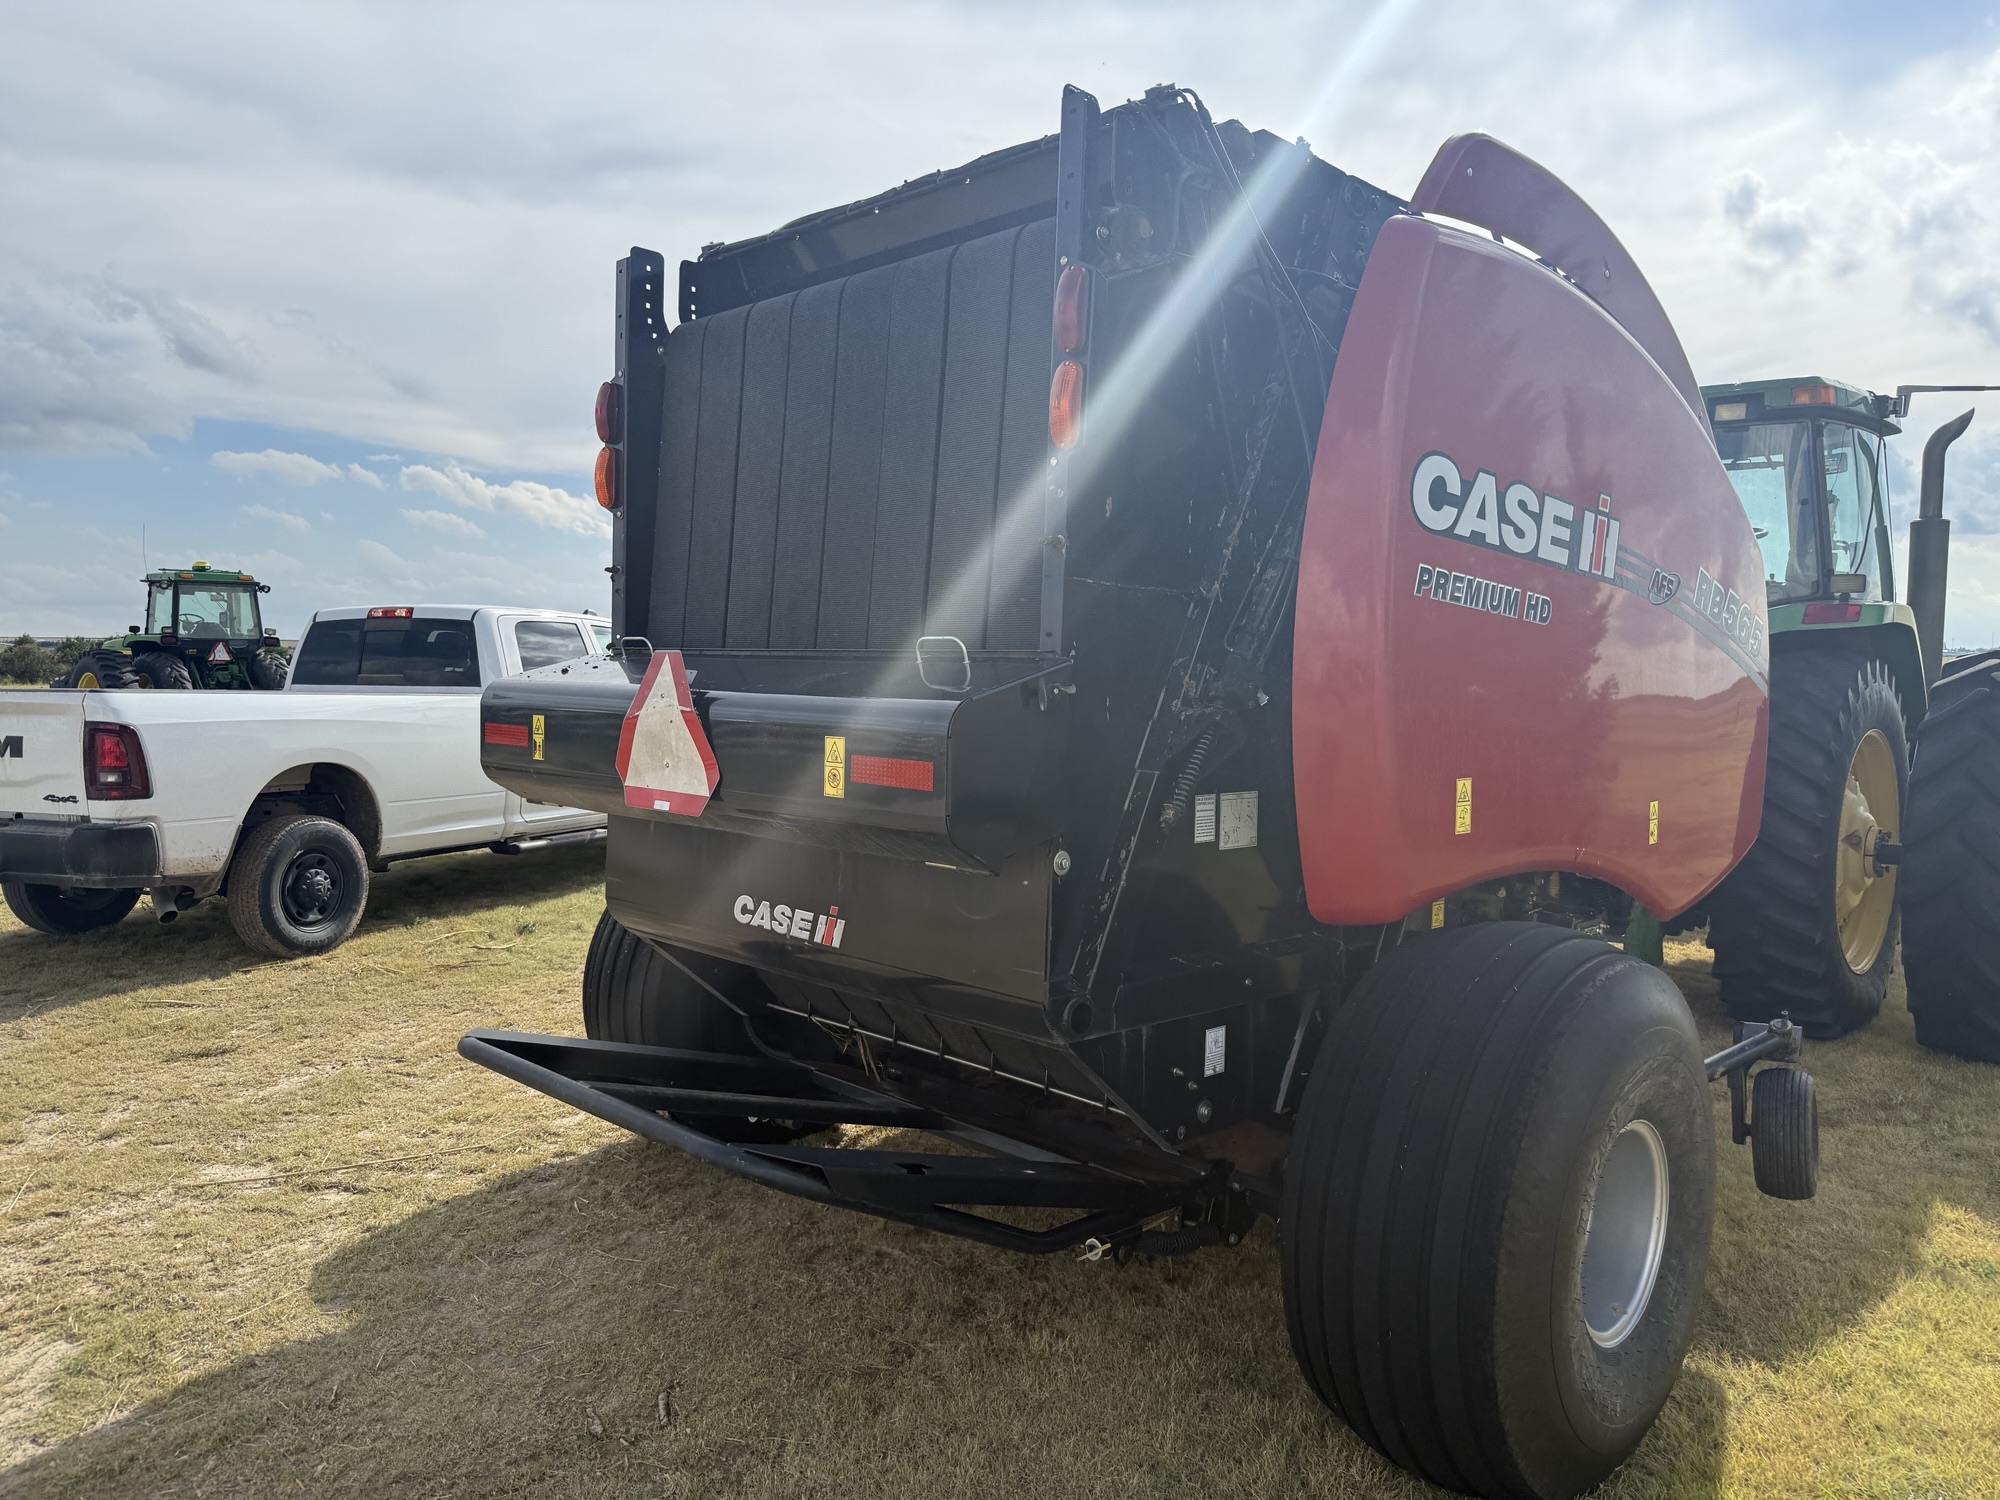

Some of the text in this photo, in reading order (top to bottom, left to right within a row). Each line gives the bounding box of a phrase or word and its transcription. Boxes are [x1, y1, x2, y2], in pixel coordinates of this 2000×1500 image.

[1411, 453, 1576, 566] CASE
[1413, 563, 1553, 626] PREMIUM HD
[1648, 568, 1676, 601] AFS
[1693, 566, 1765, 660] RB565
[733, 894, 815, 941] CASE
